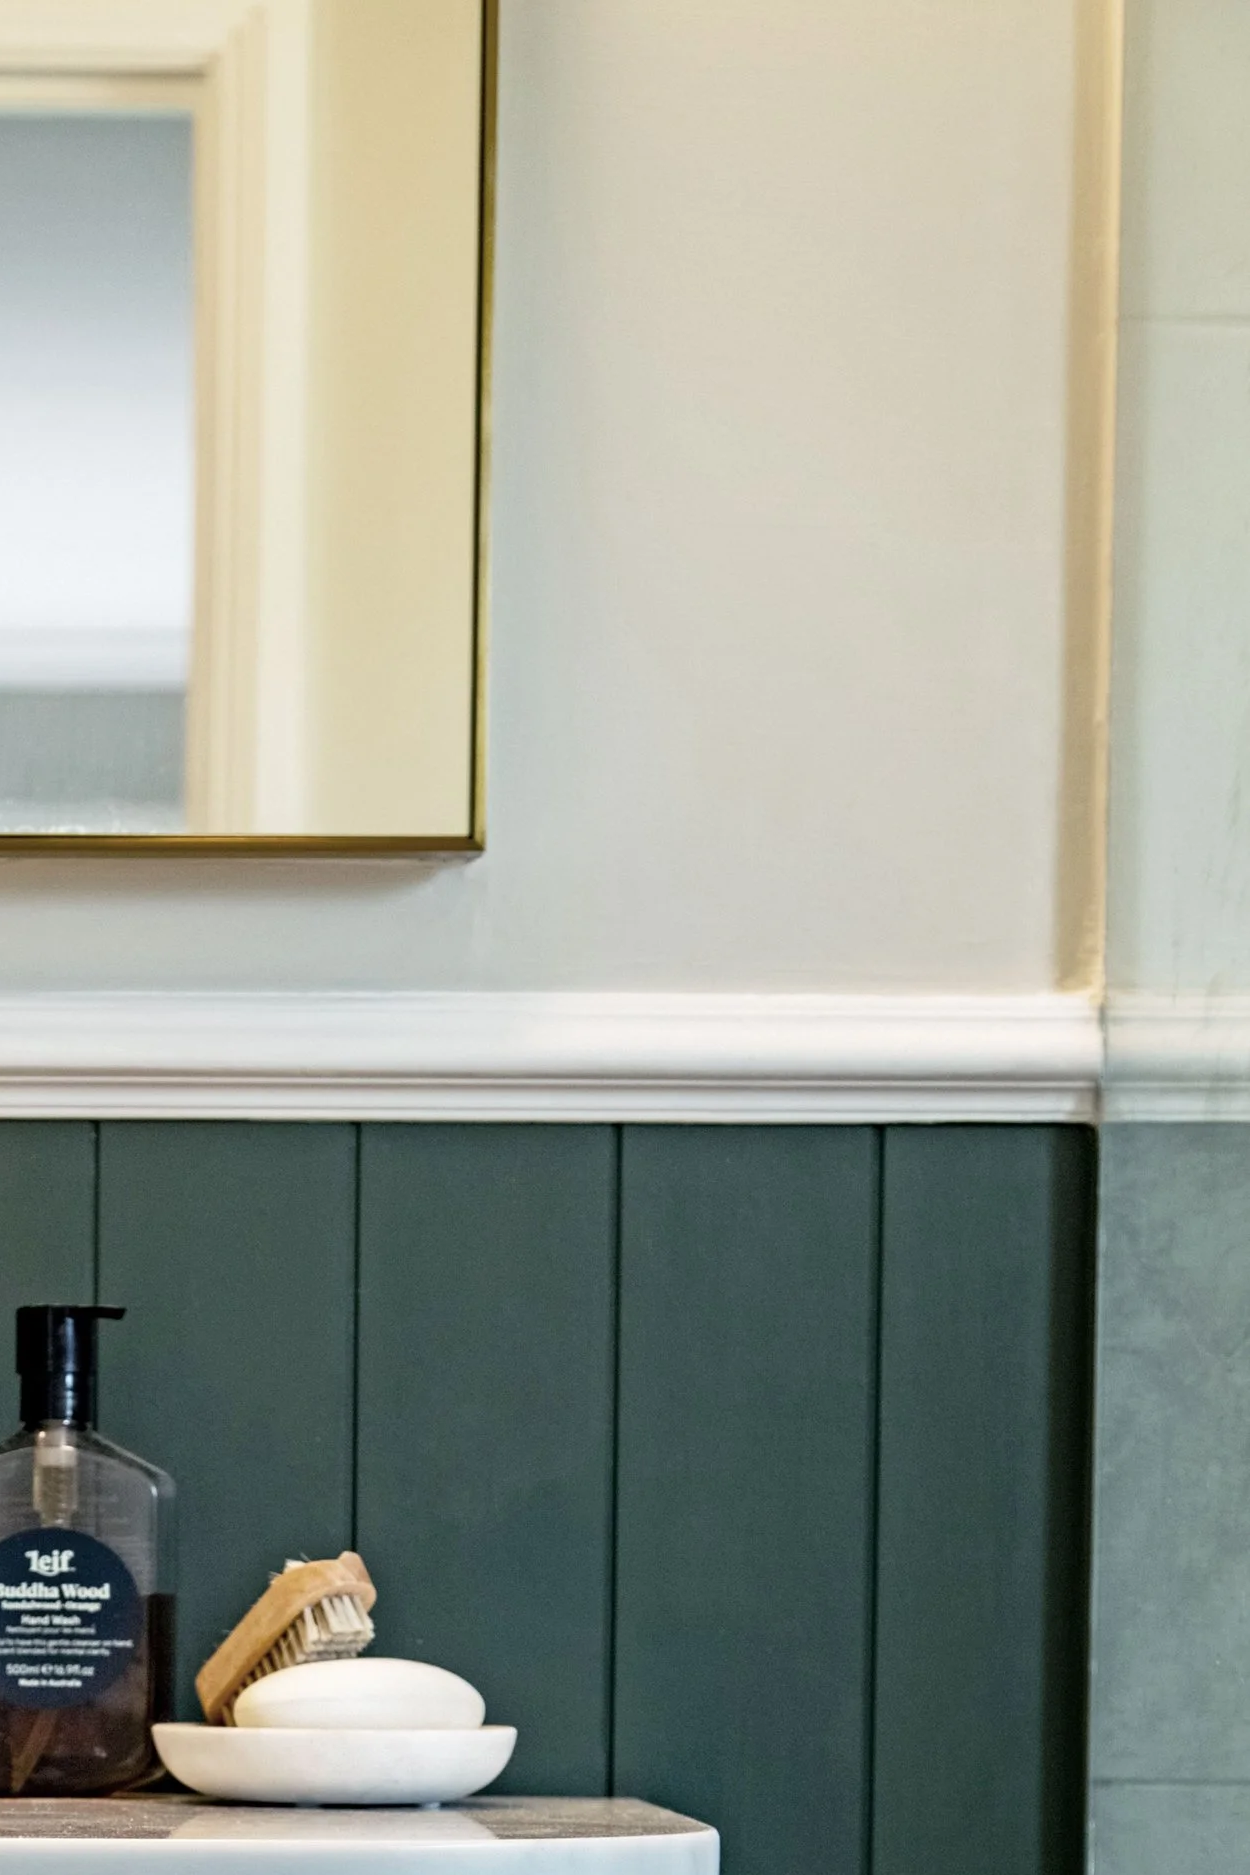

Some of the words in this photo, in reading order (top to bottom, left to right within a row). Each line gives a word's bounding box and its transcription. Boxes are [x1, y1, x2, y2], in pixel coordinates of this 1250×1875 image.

[60, 1583, 111, 1600] Wood
[20, 1614, 50, 1625] Hand
[51, 1614, 82, 1626] Wash
[5, 1663, 40, 1676] 500ml
